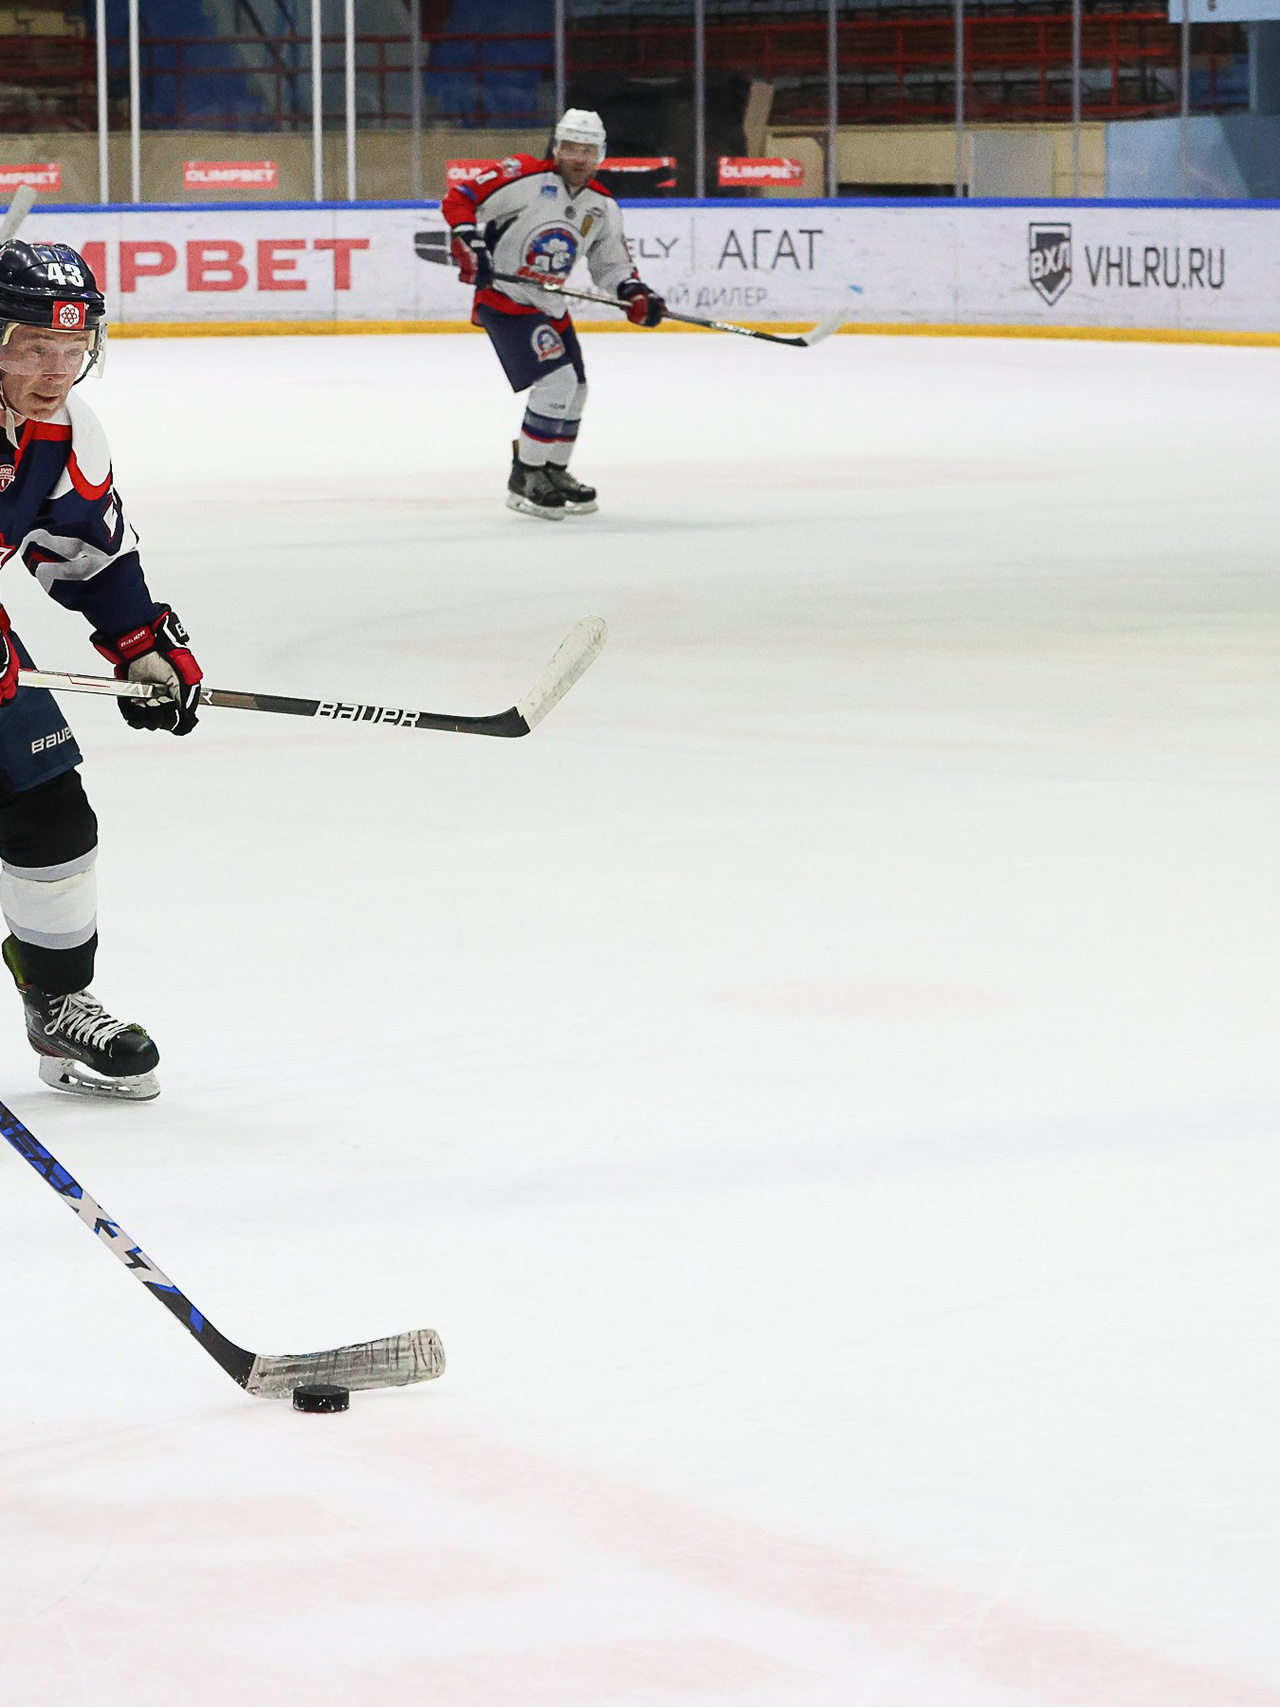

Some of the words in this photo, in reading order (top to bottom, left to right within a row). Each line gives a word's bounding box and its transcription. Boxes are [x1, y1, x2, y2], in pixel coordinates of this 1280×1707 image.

[718, 229, 823, 270] АГАТ
[1084, 245, 1226, 290] VHLRU.RU
[47, 262, 85, 287] 43
